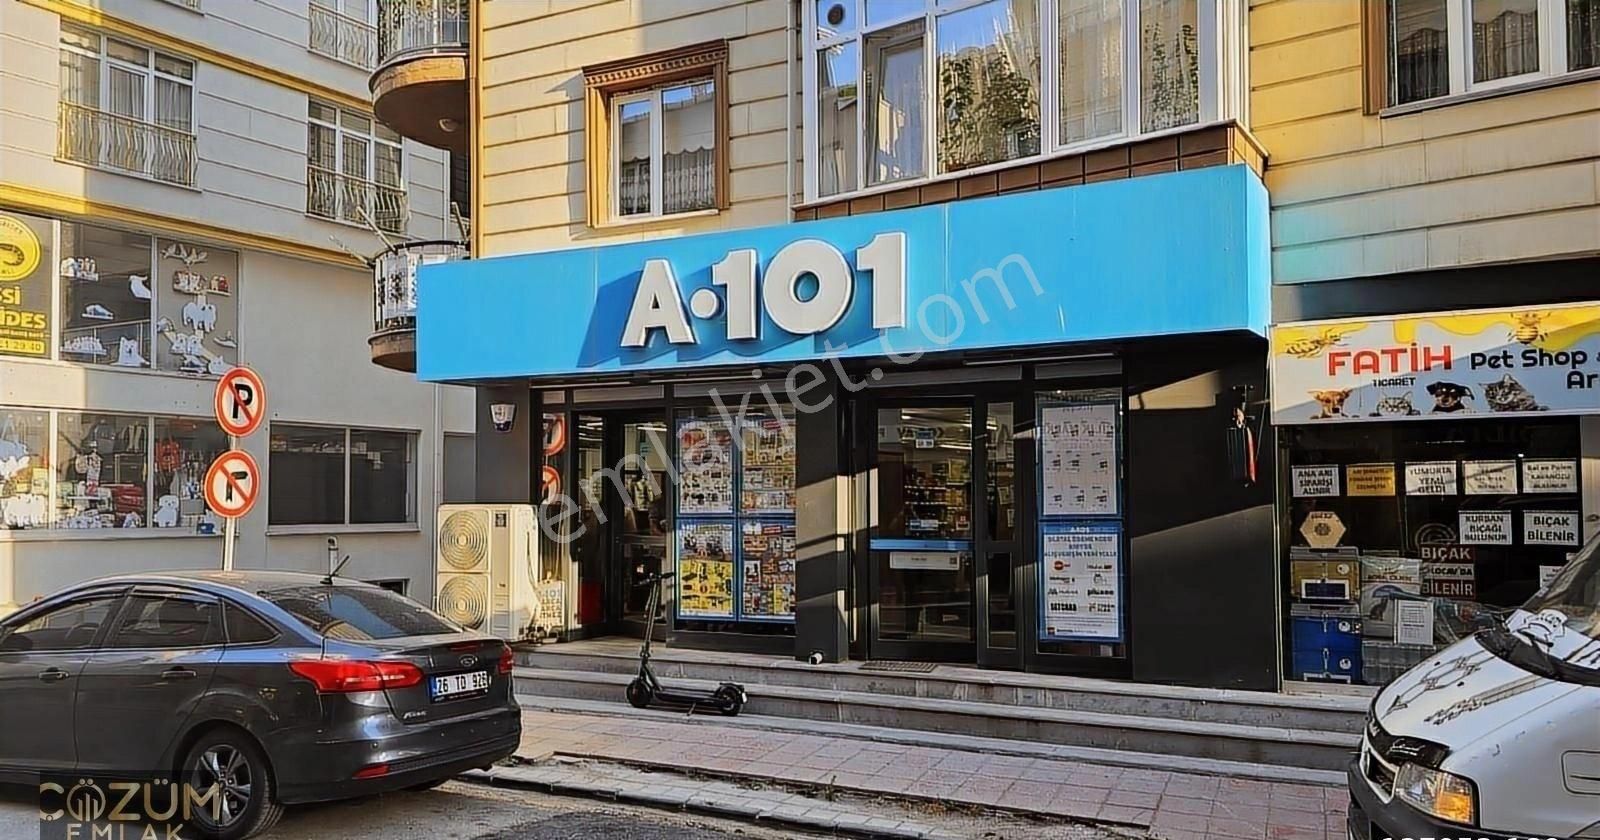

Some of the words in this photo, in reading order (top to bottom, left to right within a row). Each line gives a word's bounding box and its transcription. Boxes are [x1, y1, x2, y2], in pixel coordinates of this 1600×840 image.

[1328, 342, 1453, 376] FATİH
[1470, 350, 1514, 370] Pet
[1521, 347, 1588, 369] Shop
[232, 383, 253, 419] P
[1533, 516, 1570, 527] BIÇAK
[1527, 530, 1575, 541] BİLENİR
[1421, 547, 1472, 561] BIÇAK
